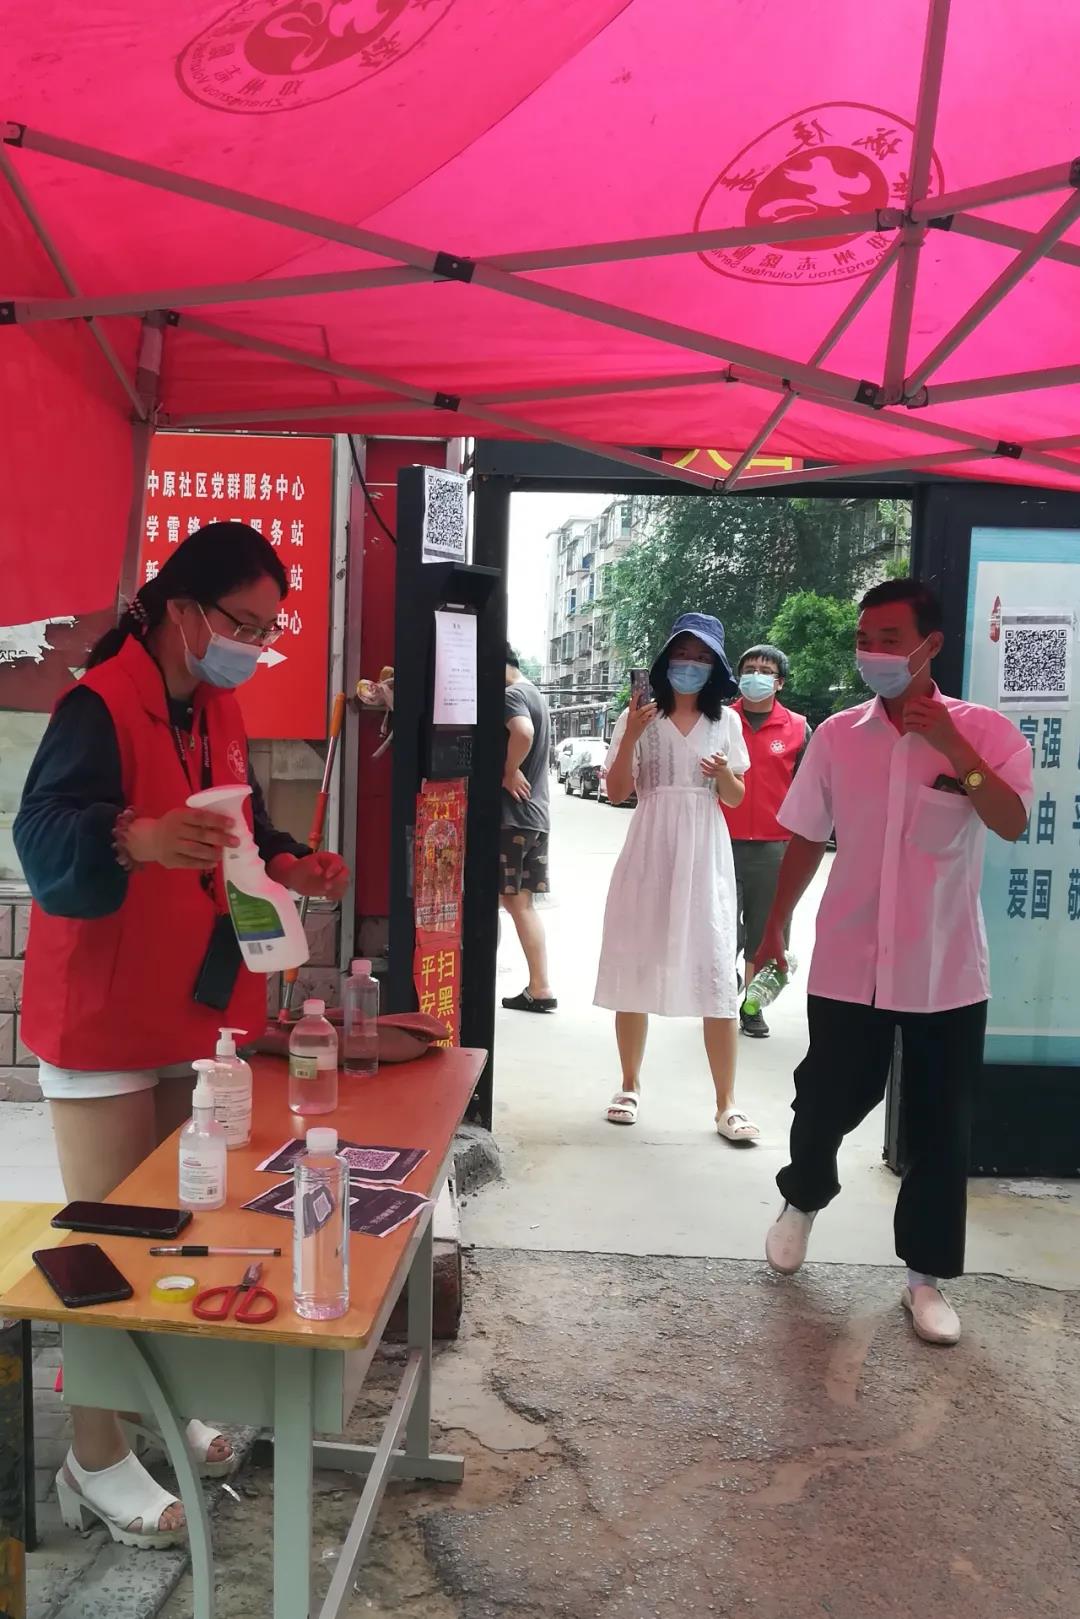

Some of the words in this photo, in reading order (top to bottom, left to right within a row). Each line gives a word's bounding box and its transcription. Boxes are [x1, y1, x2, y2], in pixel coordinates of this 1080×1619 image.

[147, 470, 305, 501] 中原社区党群服务中心
[146, 515, 305, 547] 学雷锋服务站
[1007, 868, 1053, 920] 爱国
